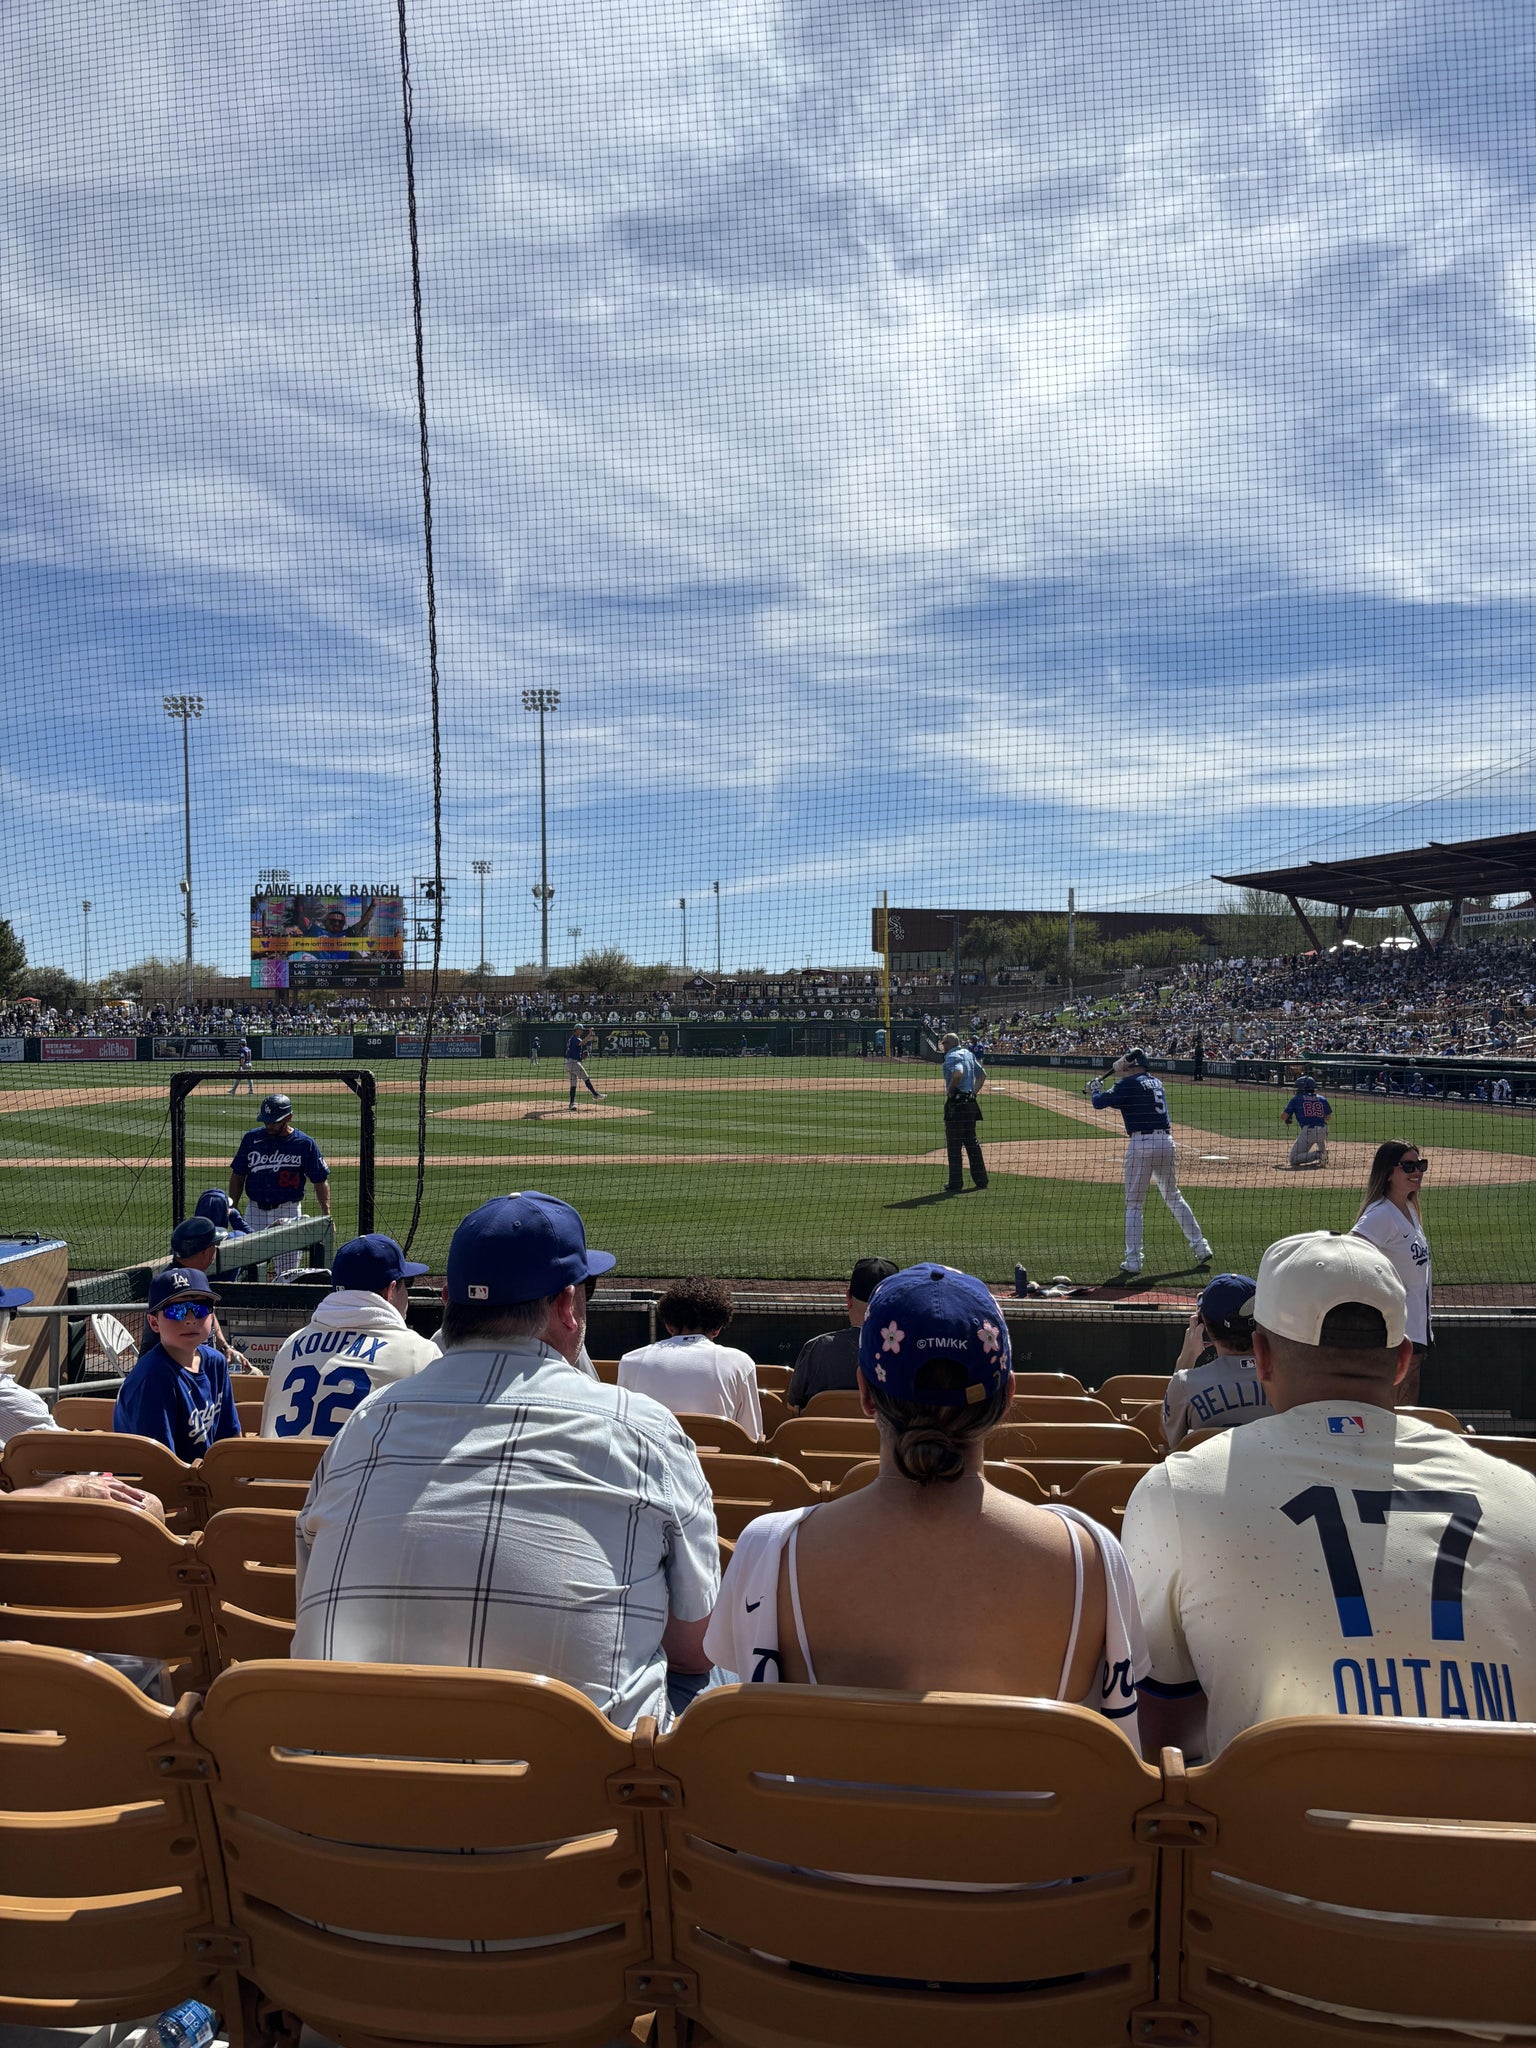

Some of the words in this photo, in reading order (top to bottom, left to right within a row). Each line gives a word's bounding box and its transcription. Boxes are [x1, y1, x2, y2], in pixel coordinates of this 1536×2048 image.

[254, 884, 342, 897] CAMELBACK
[350, 884, 400, 897] RANCH
[1463, 913, 1496, 923] ESTRELLA
[99, 1041, 129, 1056] CHICAGO
[1153, 1089, 1167, 1114] 5
[247, 1149, 302, 1172] Dodgers
[171, 1271, 191, 1289] LA
[291, 1330, 389, 1363] KOUFAX
[275, 1364, 372, 1438] 32
[1280, 1485, 1483, 1641] 17
[1332, 1657, 1517, 1722] OHTANI
